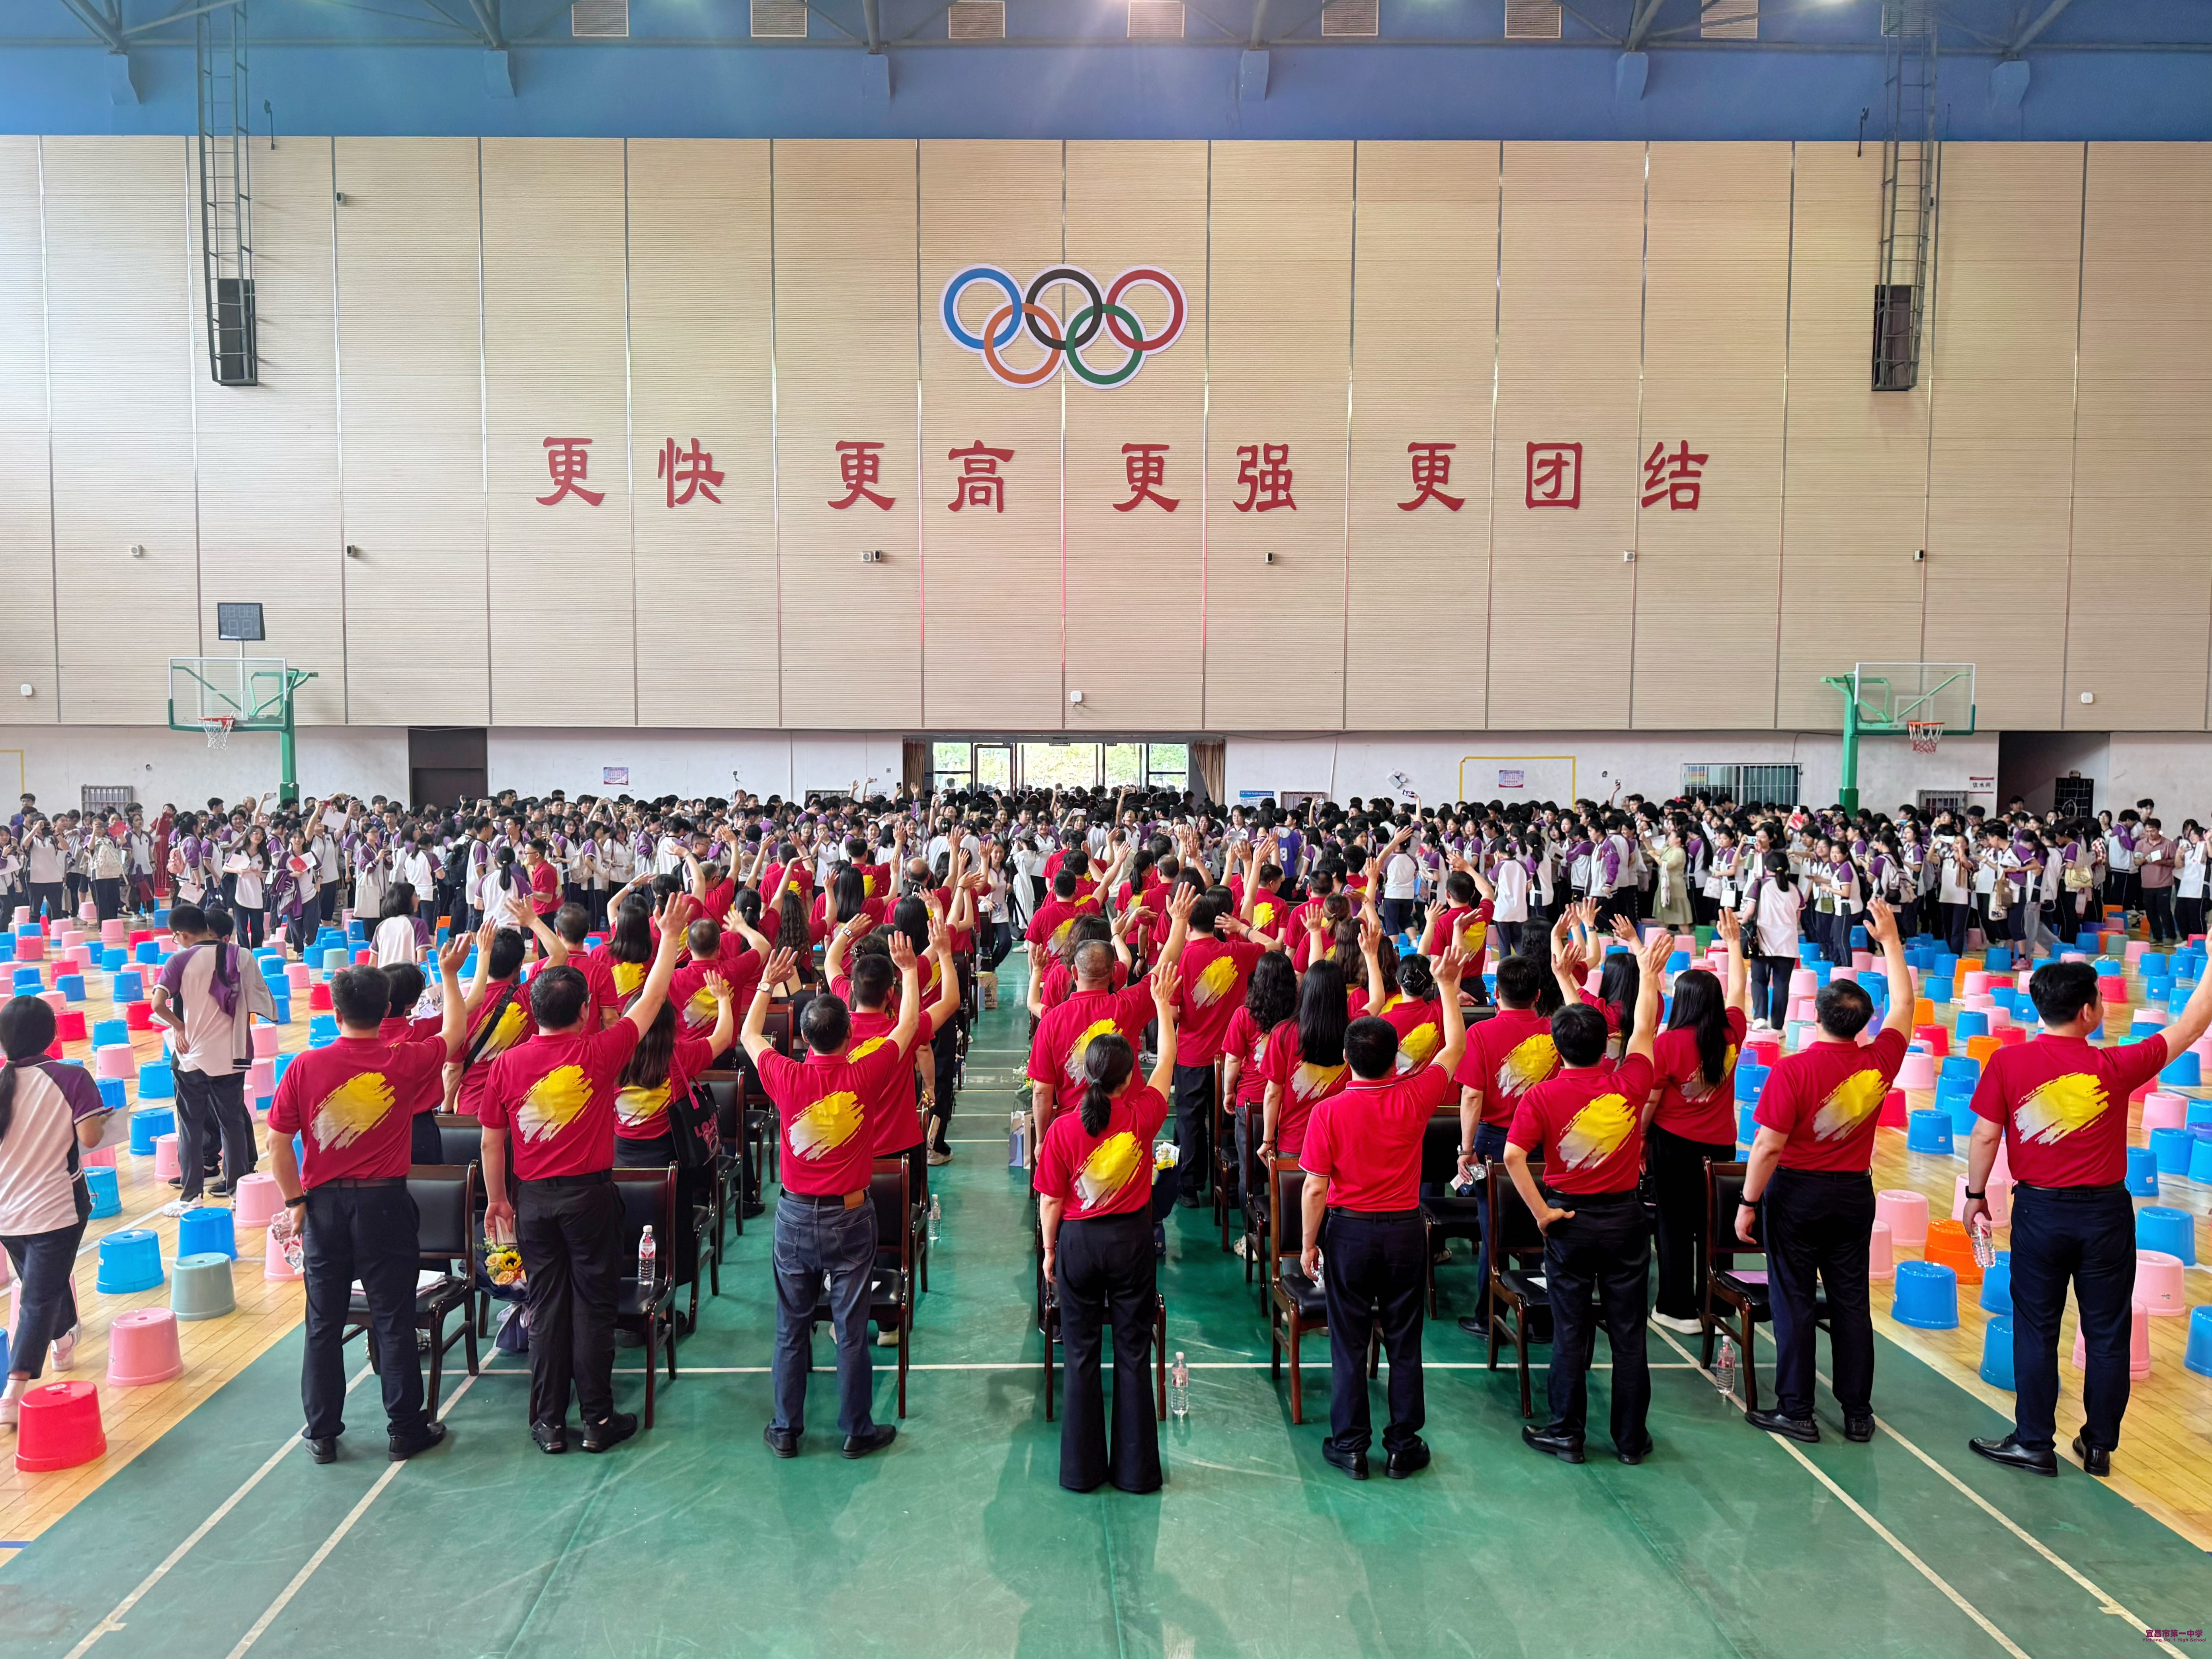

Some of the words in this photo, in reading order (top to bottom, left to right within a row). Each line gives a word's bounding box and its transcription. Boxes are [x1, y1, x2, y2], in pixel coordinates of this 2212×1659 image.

[537, 438, 724, 507] 更快
[828, 440, 1015, 513] 更高
[1113, 443, 1296, 512] 更强
[1398, 441, 1708, 511] 更团结
